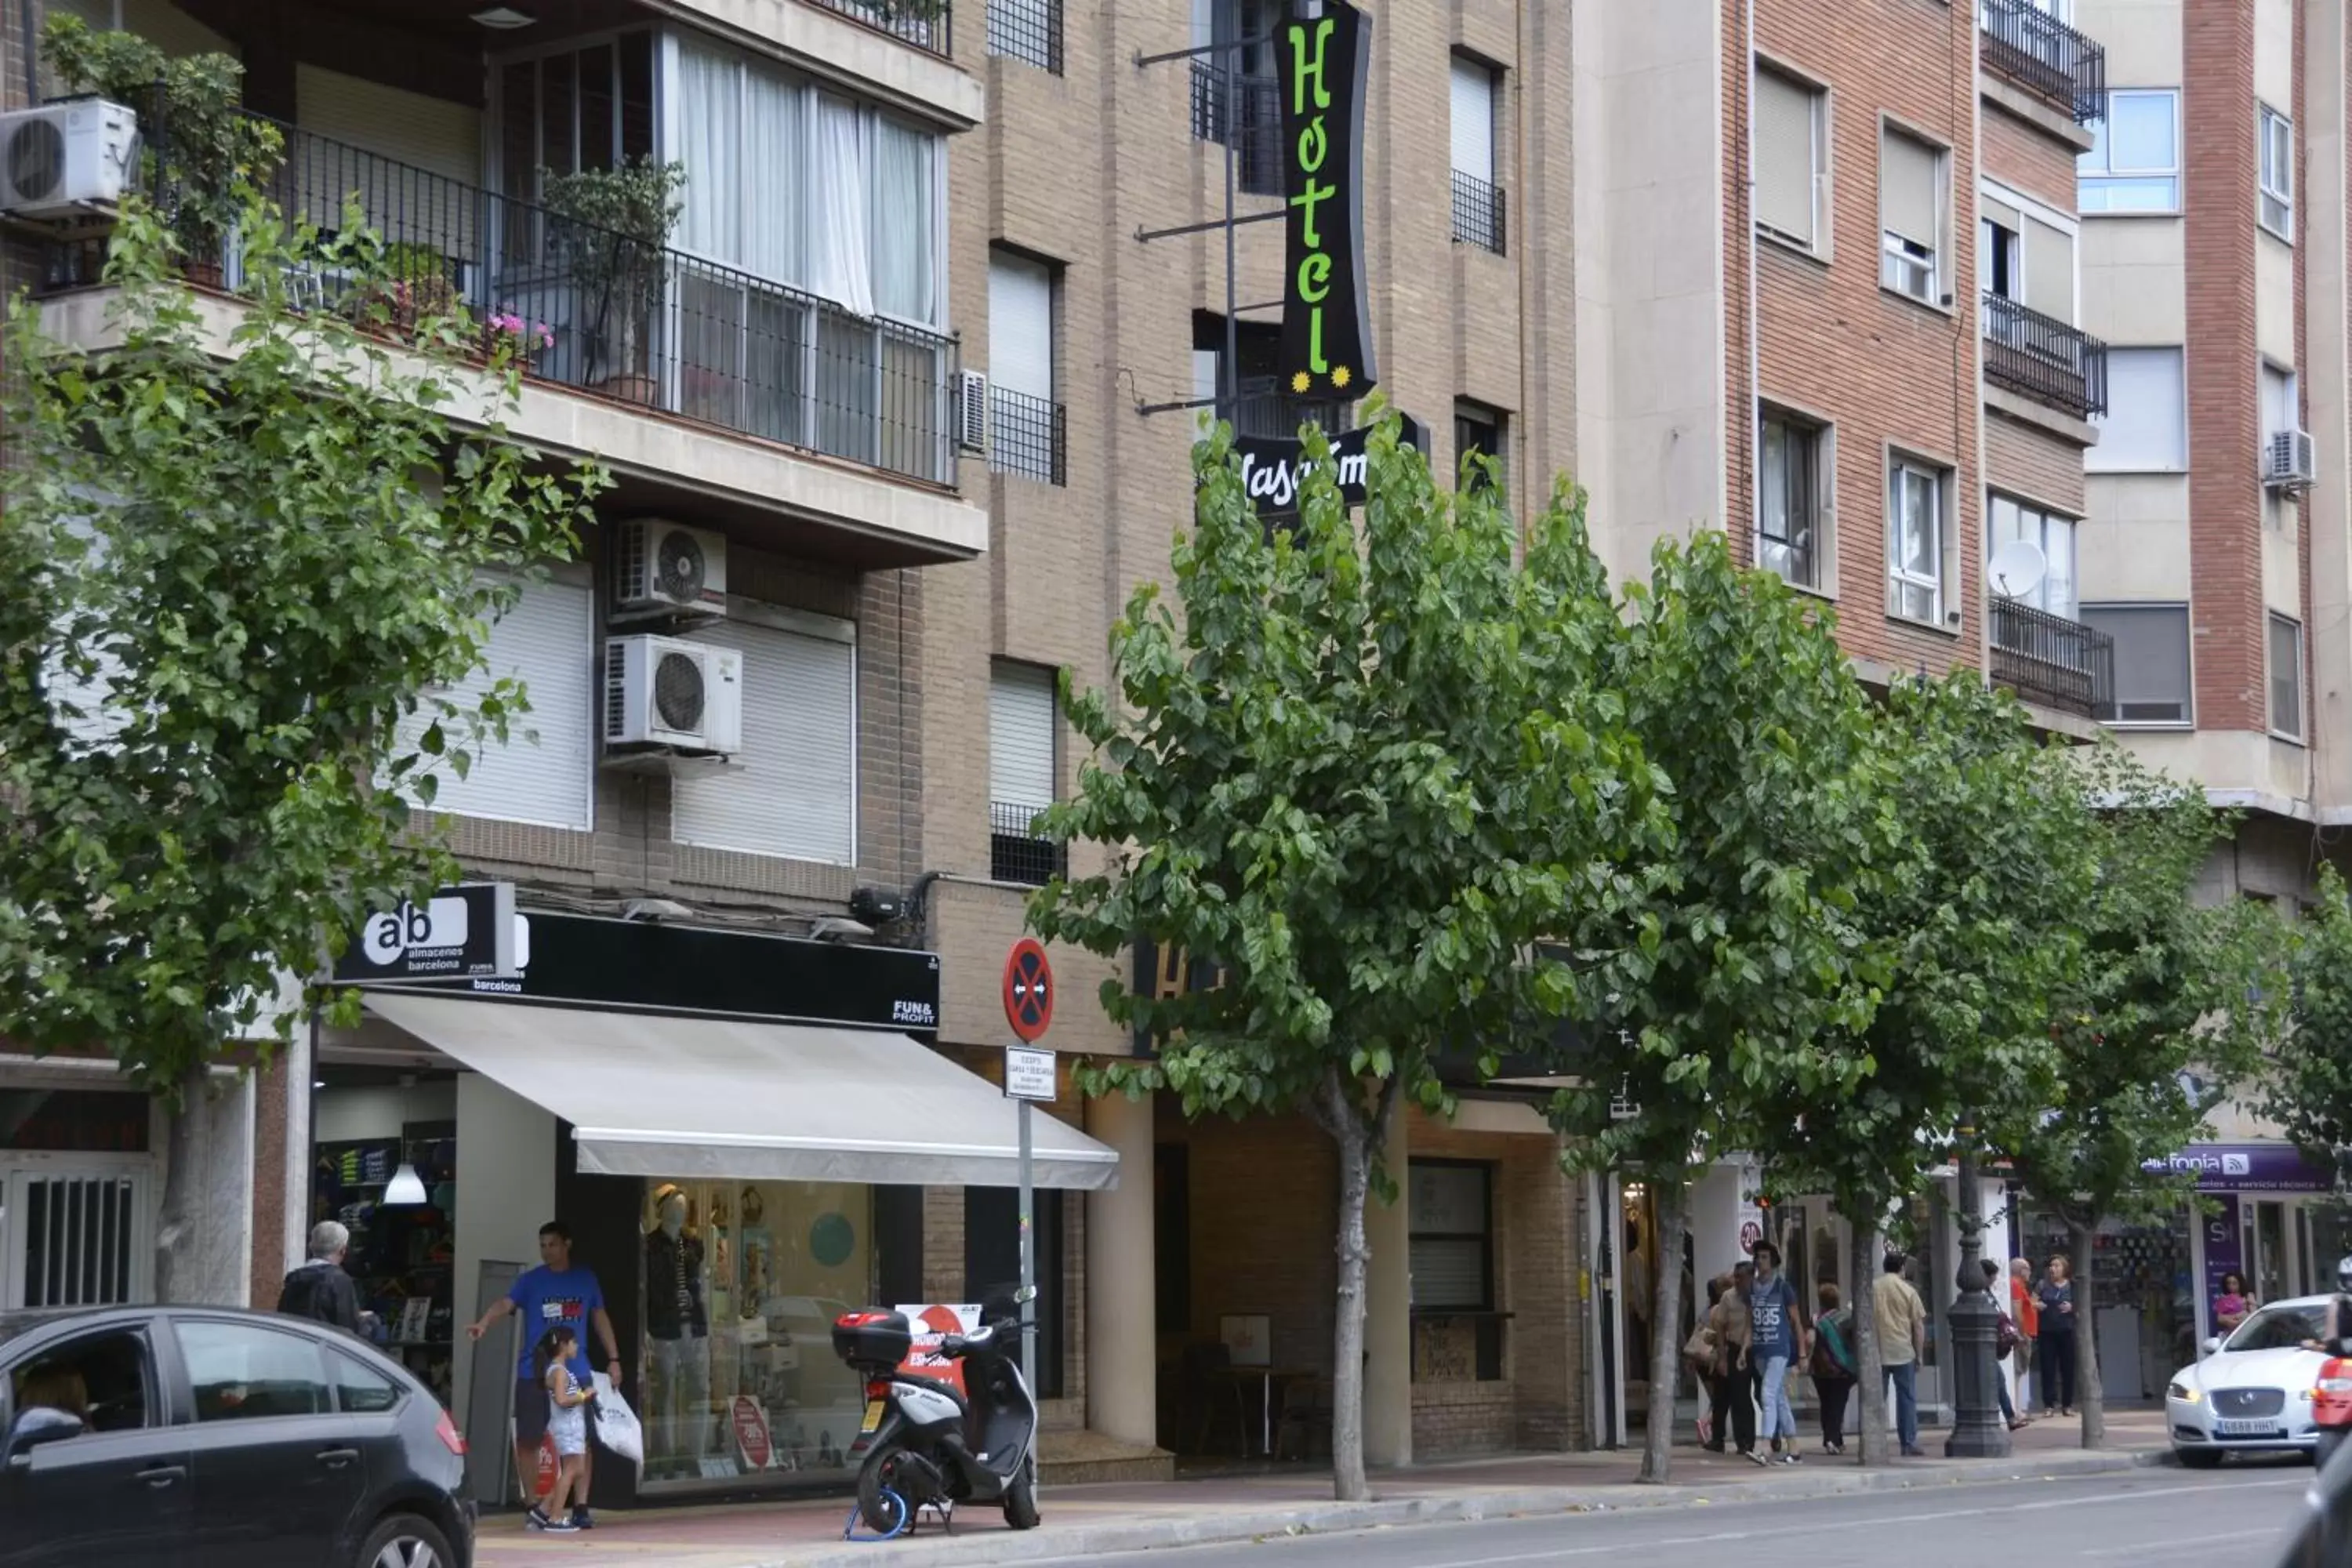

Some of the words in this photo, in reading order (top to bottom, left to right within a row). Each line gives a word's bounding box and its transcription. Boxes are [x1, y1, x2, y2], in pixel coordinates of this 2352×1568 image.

[1289, 18, 1336, 375] Hotel
[378, 901, 431, 949] ab
[408, 946, 464, 958] almacenes
[408, 959, 459, 971] barcelona
[474, 979, 521, 992] barcelona
